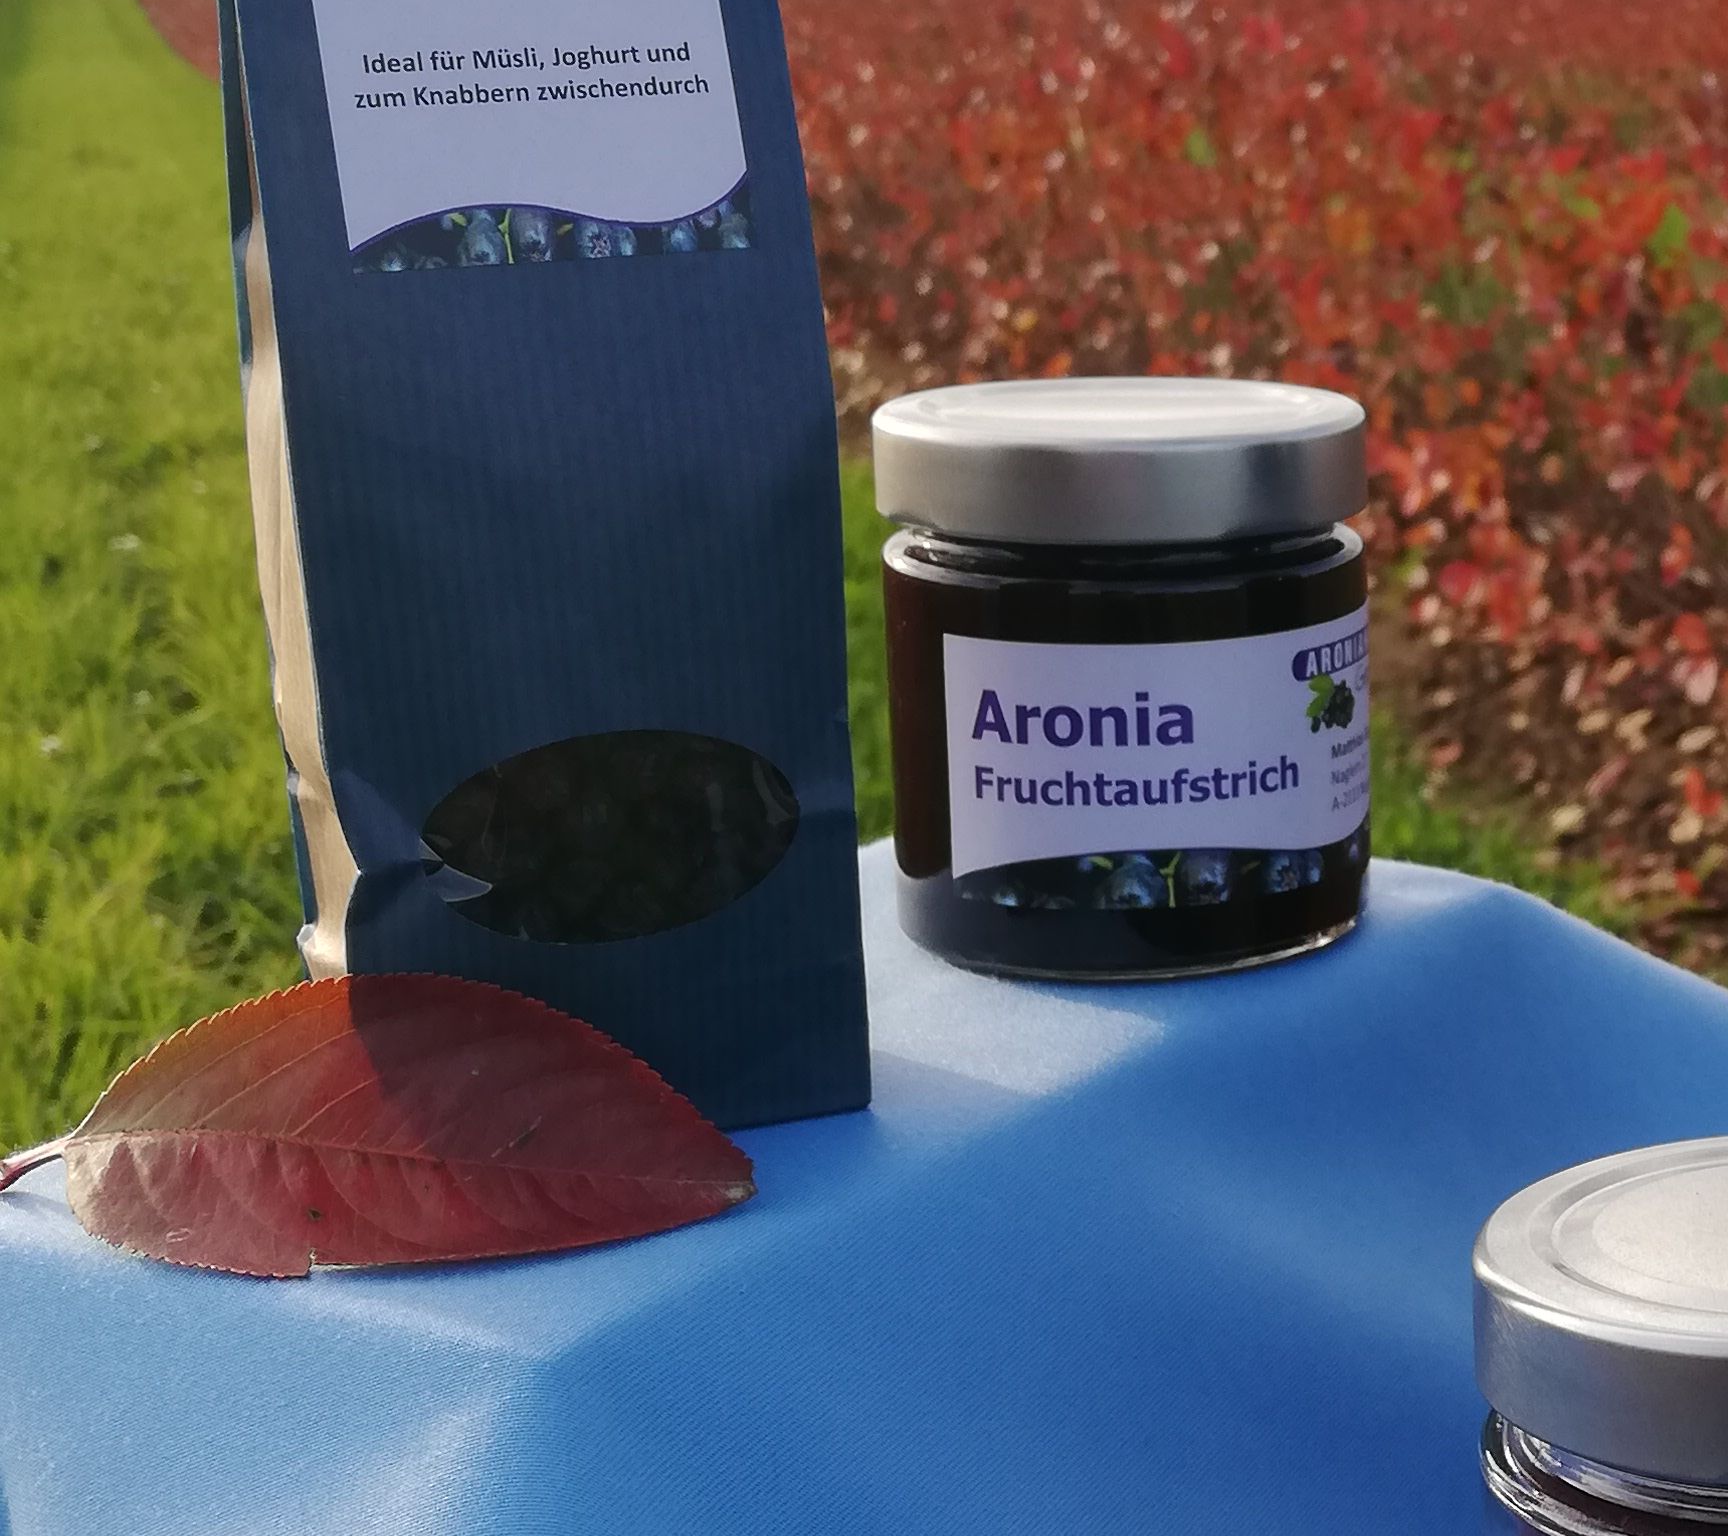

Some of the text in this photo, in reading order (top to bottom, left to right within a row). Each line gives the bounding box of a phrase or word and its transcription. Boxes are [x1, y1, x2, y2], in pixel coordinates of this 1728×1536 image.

[362, 42, 692, 75] Ideal für Müsli, Joghurt und
[354, 75, 711, 110] zum Knabbern zwischendurch
[971, 689, 1195, 748] Aronia
[974, 755, 1300, 807] Fruchtaufstrich
